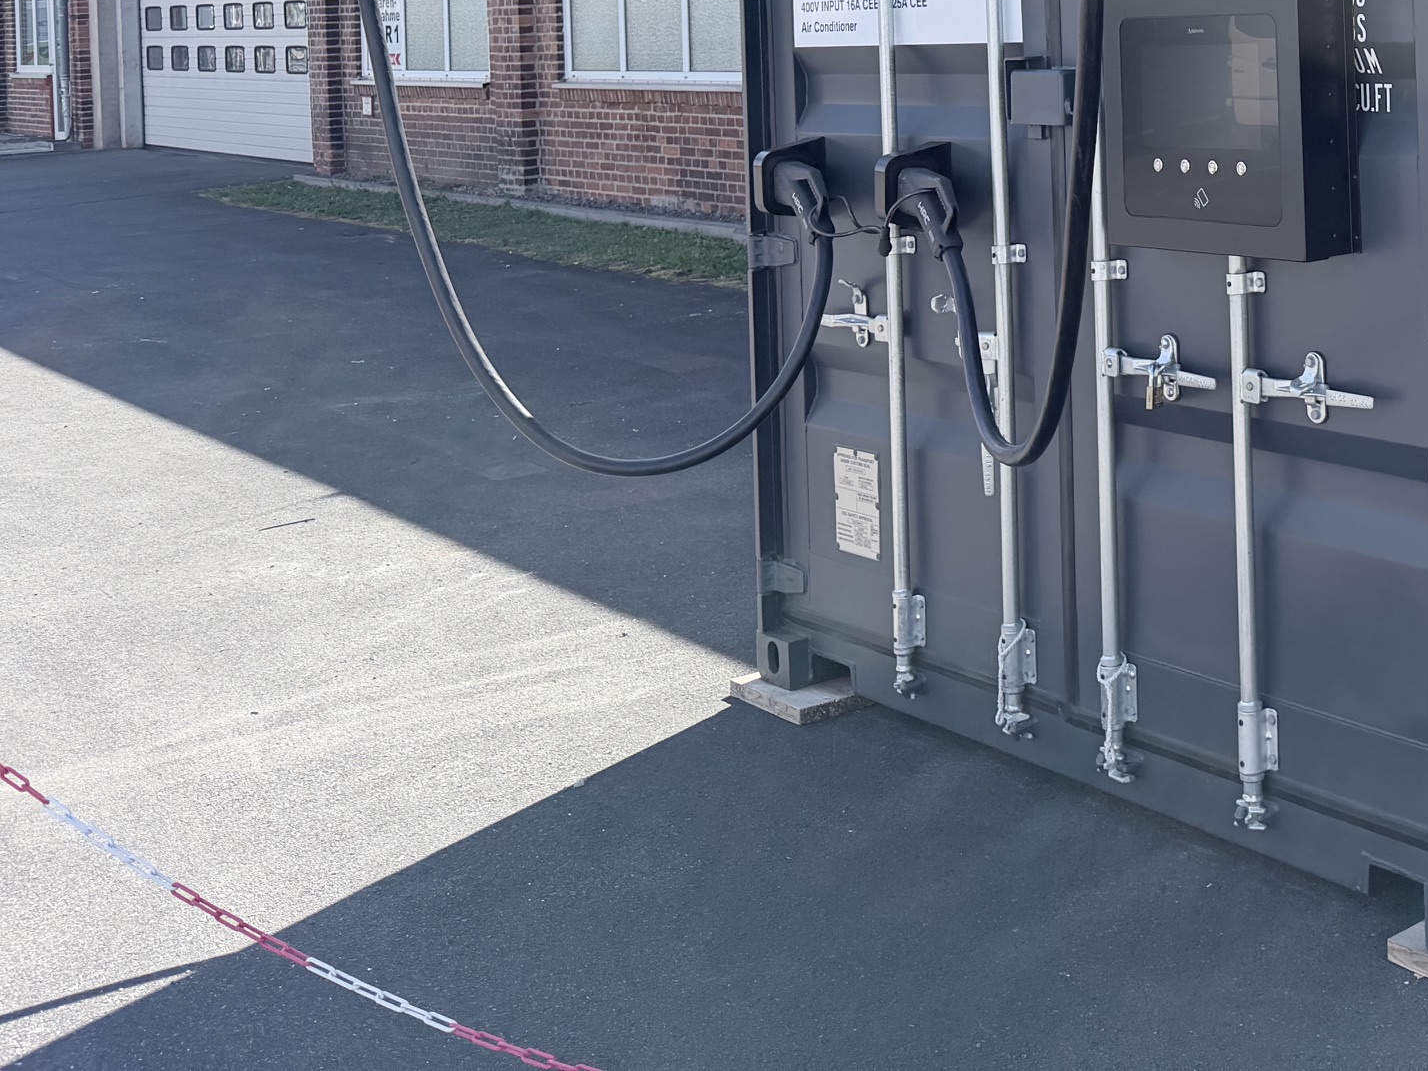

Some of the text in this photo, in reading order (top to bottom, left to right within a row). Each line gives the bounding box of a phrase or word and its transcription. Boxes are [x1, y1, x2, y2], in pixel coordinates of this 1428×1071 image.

[801, 0, 819, 13] 400V
[821, 0, 844, 12] INPUT
[381, 9, 400, 22] ahme
[801, 20, 858, 34] Air Conditioner
[1354, 48, 1382, 74] U.M
